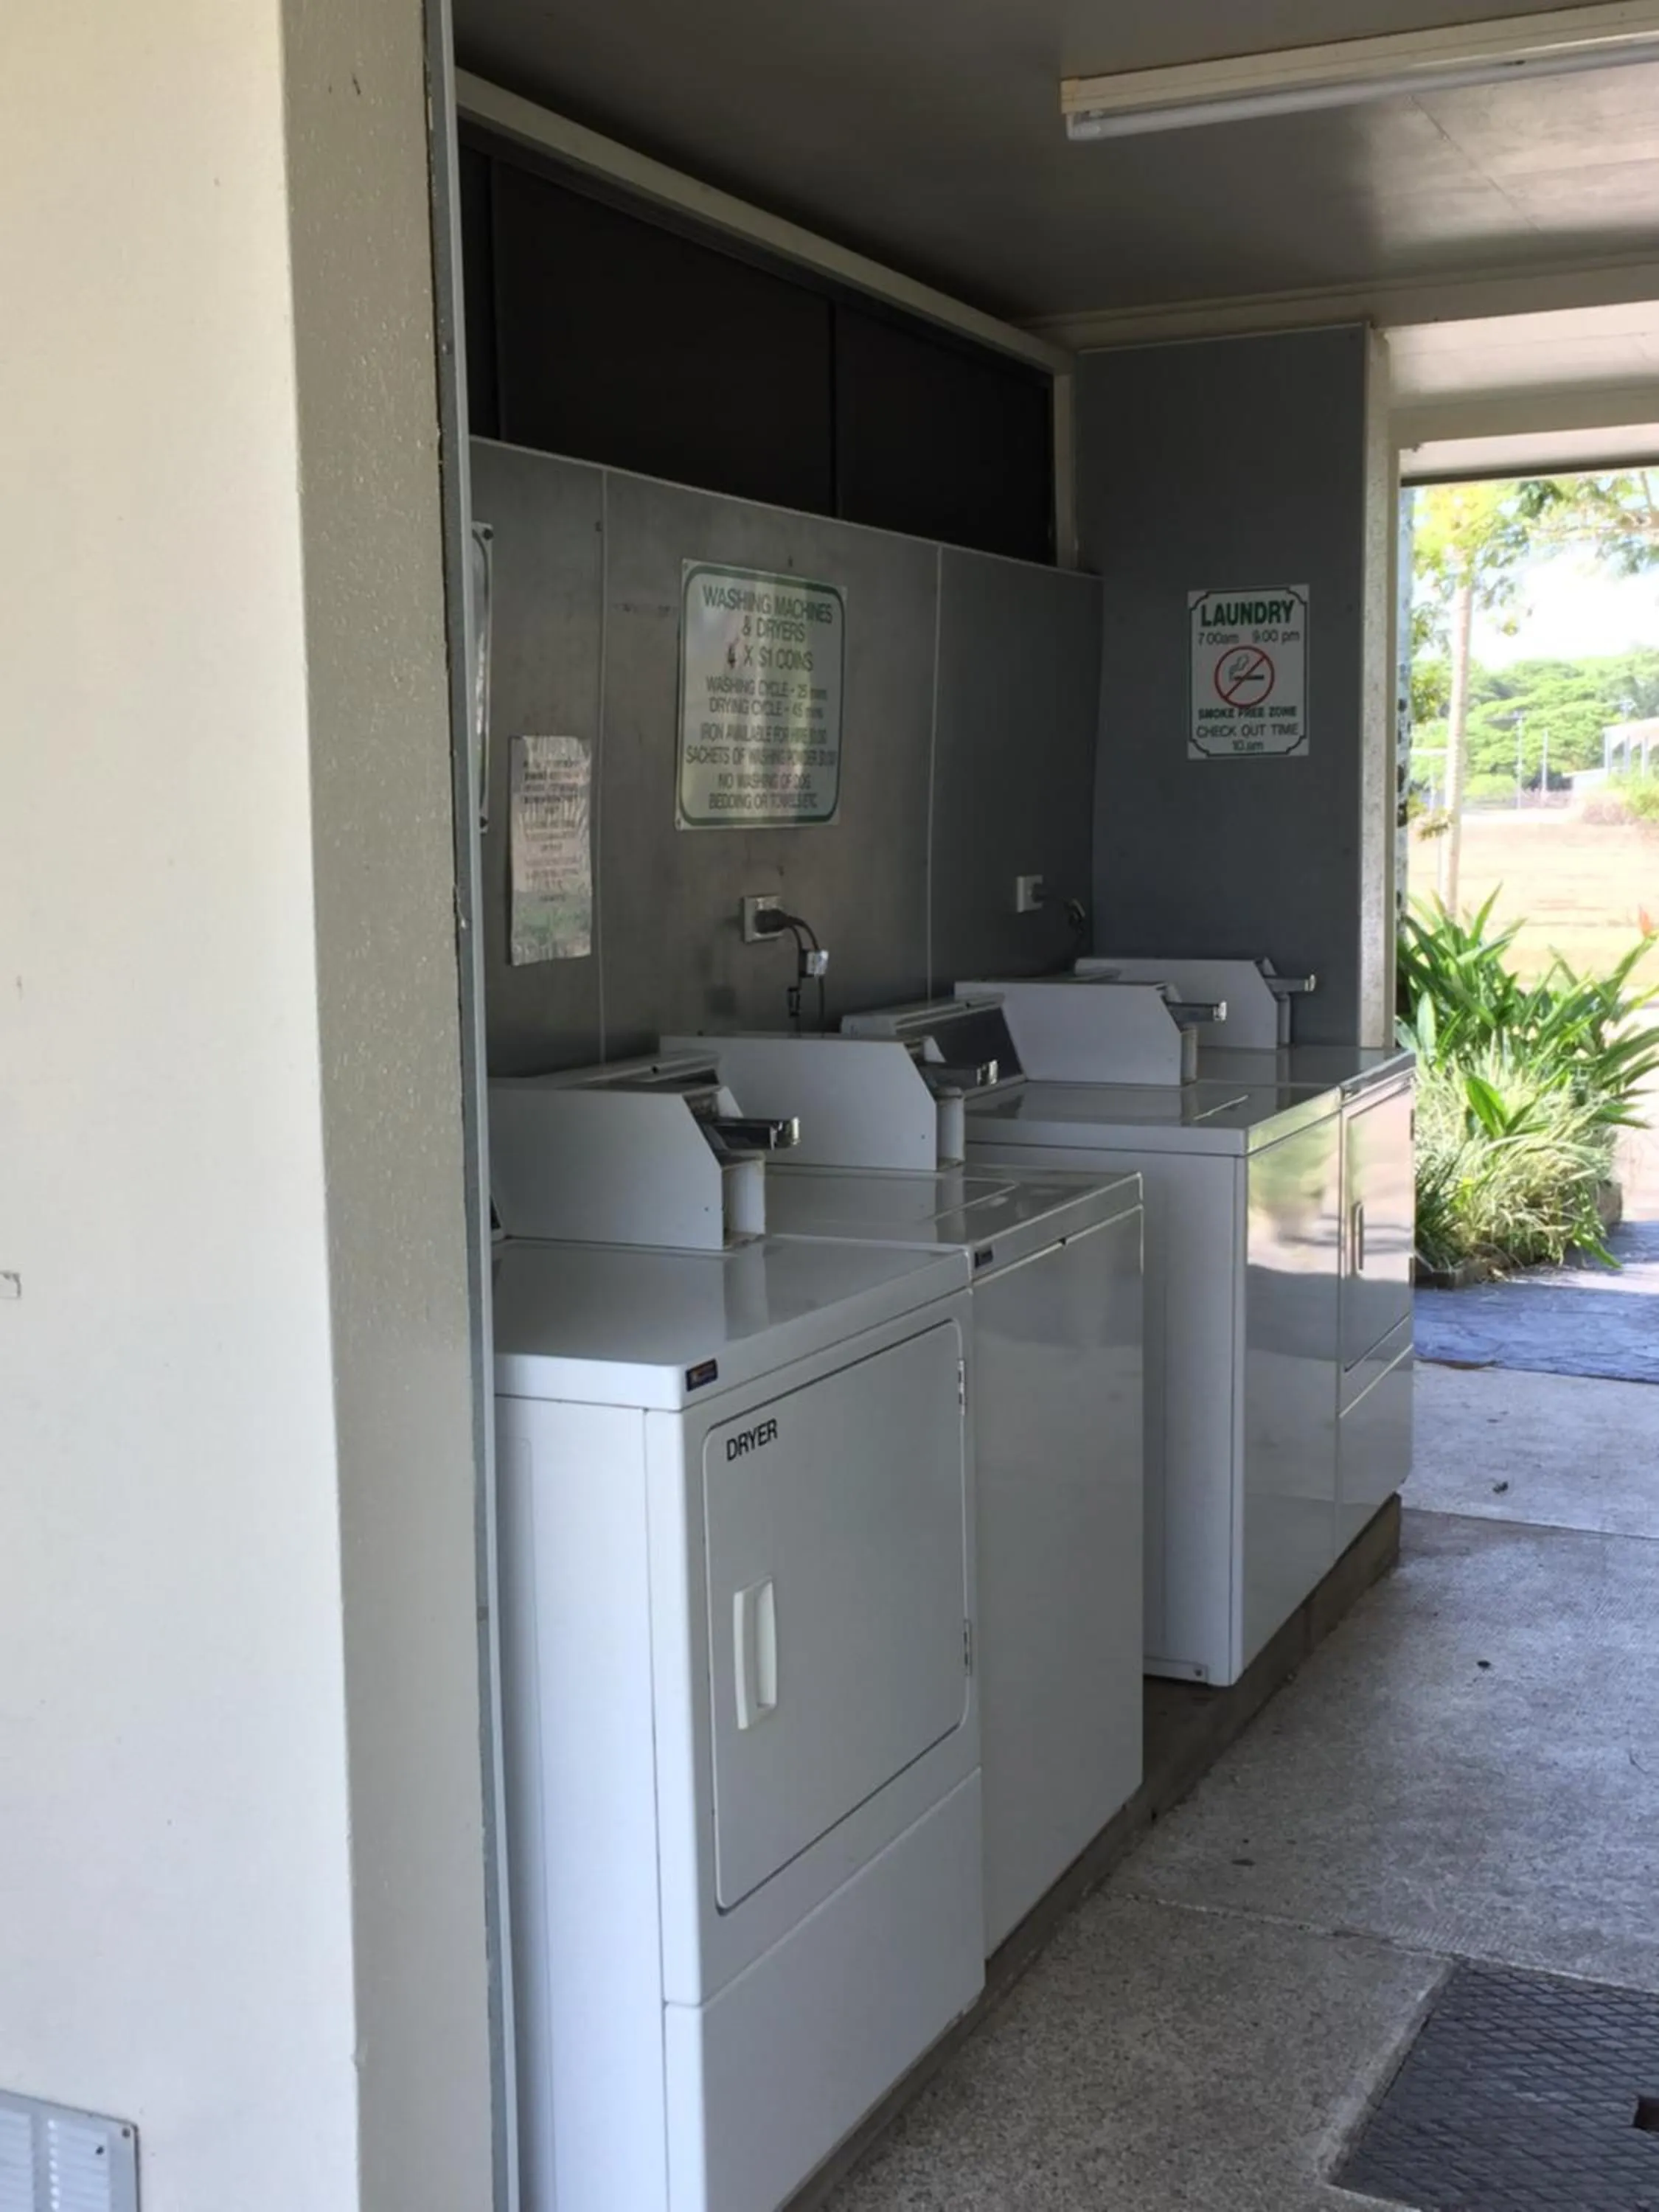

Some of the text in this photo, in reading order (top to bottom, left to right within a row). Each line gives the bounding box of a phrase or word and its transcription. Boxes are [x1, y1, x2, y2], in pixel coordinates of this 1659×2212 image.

[703, 585, 833, 624] WASHING MACHINES
[1200, 600, 1295, 627] LAUNDRY
[742, 615, 806, 642] & DRYERS
[744, 644, 754, 667] X
[776, 648, 814, 672] COINS
[706, 675, 755, 695] WASHING
[709, 697, 749, 715] DRYING
[1198, 707, 1235, 720] SMOKE
[1269, 705, 1298, 718] ZONE
[1196, 723, 1299, 738] CHECK OUT TIME
[726, 1417, 778, 1462] DRYER
